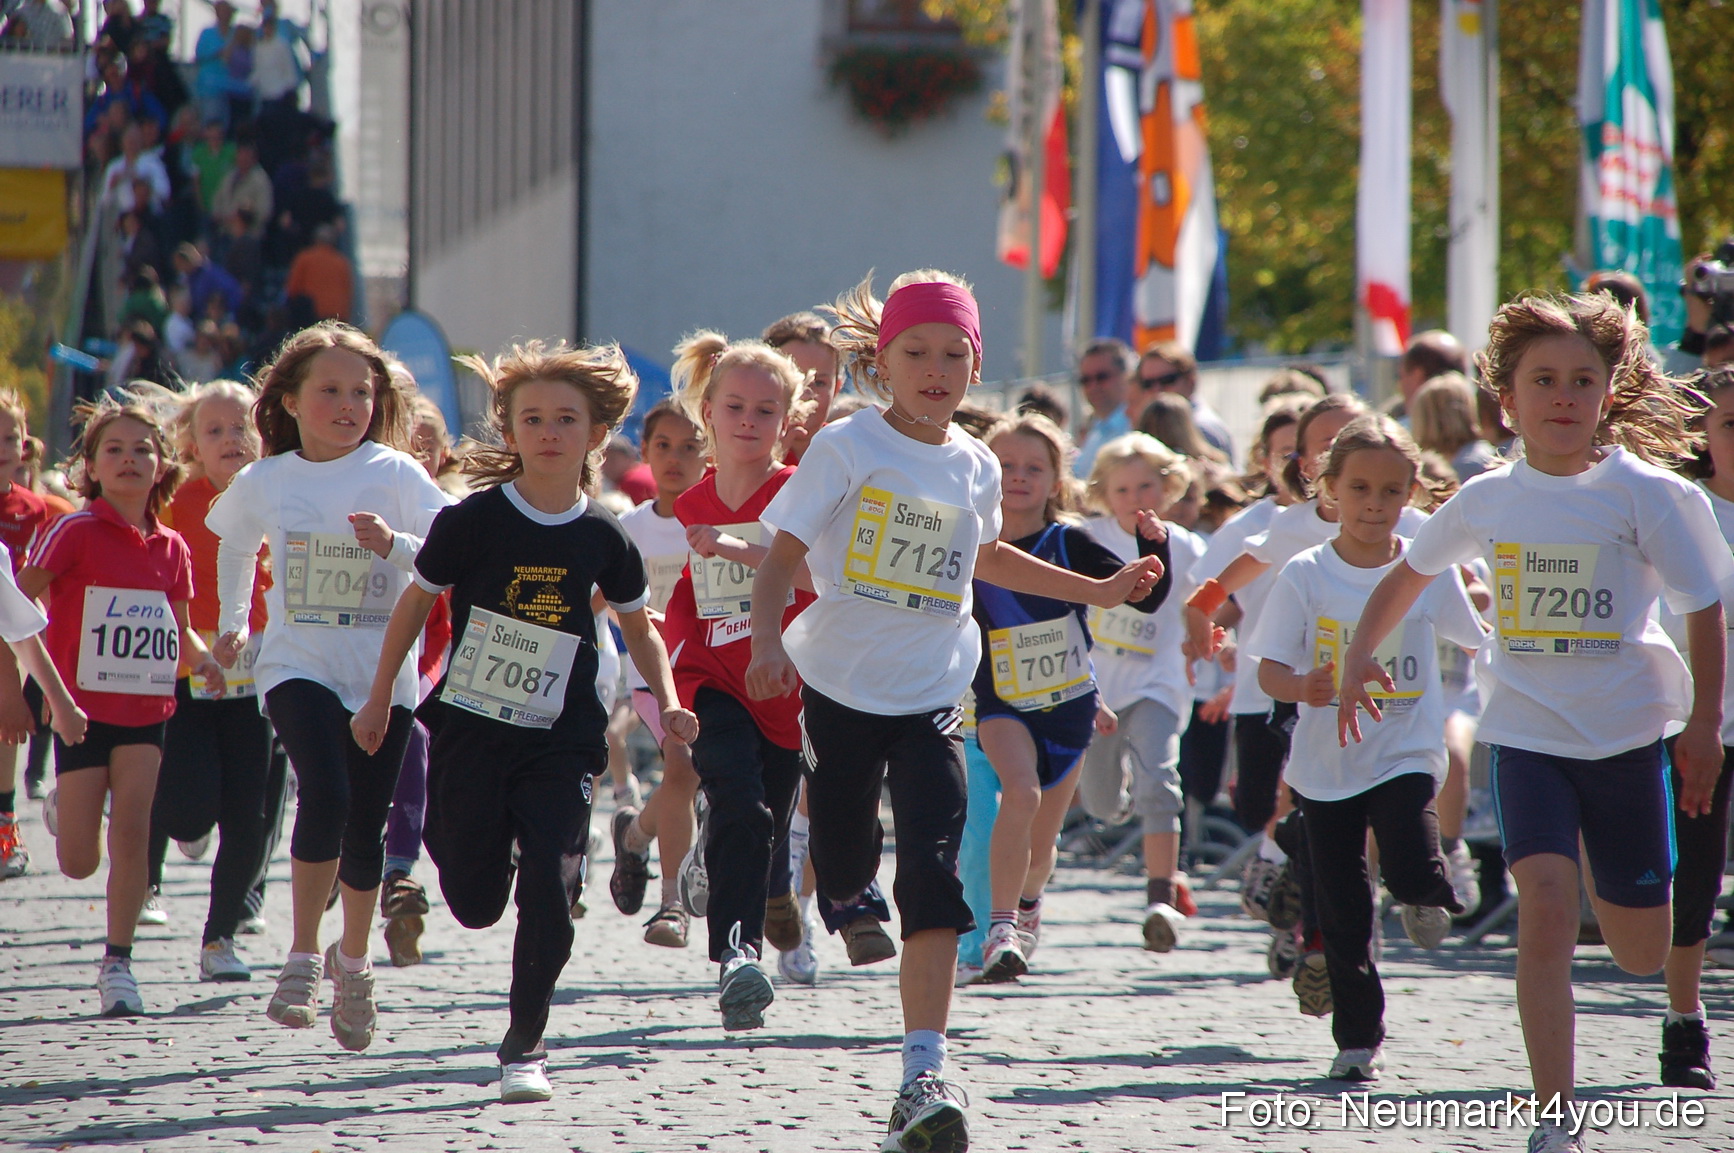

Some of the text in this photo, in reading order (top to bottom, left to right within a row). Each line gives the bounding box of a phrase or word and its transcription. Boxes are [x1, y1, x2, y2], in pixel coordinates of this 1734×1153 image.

[894, 502, 942, 532] Sarah
[857, 527, 875, 545] K3
[315, 539, 371, 560] Luciana
[889, 537, 962, 581] 7125
[513, 566, 568, 576] NEUMARKTER
[1526, 551, 1579, 573] Hanna
[288, 566, 302, 580] K3
[316, 568, 388, 598] 7049
[517, 573, 562, 583] STADTLAUF
[1501, 584, 1513, 600] K3
[106, 595, 164, 618] Lena
[518, 603, 571, 613] BAMBINILAUF
[921, 595, 961, 612] PFLEIDERER
[1527, 587, 1614, 619] 7208
[1105, 612, 1156, 641] 7199
[91, 623, 178, 661] 10206
[491, 624, 539, 655] Selina
[1016, 628, 1064, 649] Jasmin
[1570, 639, 1620, 650] PFLEIDERER
[459, 644, 476, 660] K3
[996, 660, 1010, 673] K3
[1021, 645, 1081, 681] 7071
[484, 655, 560, 698] 7087
